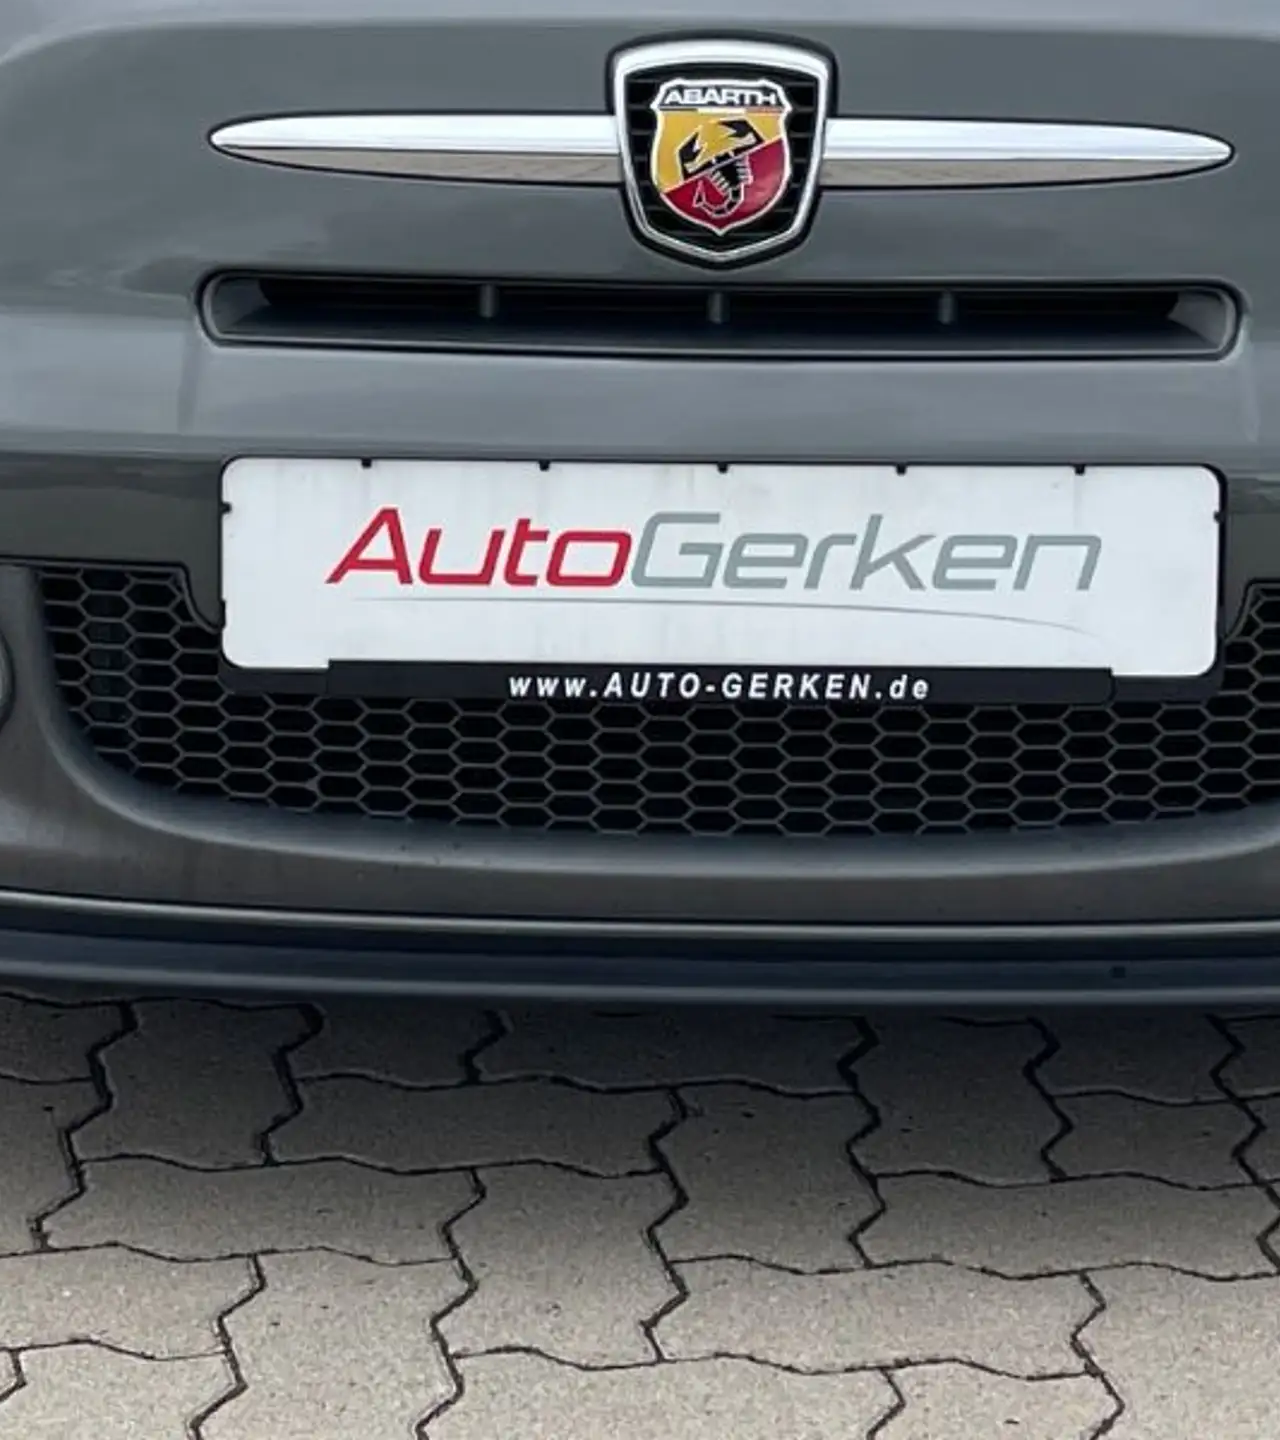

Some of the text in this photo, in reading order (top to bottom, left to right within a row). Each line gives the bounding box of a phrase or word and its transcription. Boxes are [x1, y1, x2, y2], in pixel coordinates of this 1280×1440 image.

[664, 87, 777, 106] ABARTH
[325, 506, 1102, 593] AutoGerken
[508, 671, 931, 703] www.AUTO-GERKEN.de
